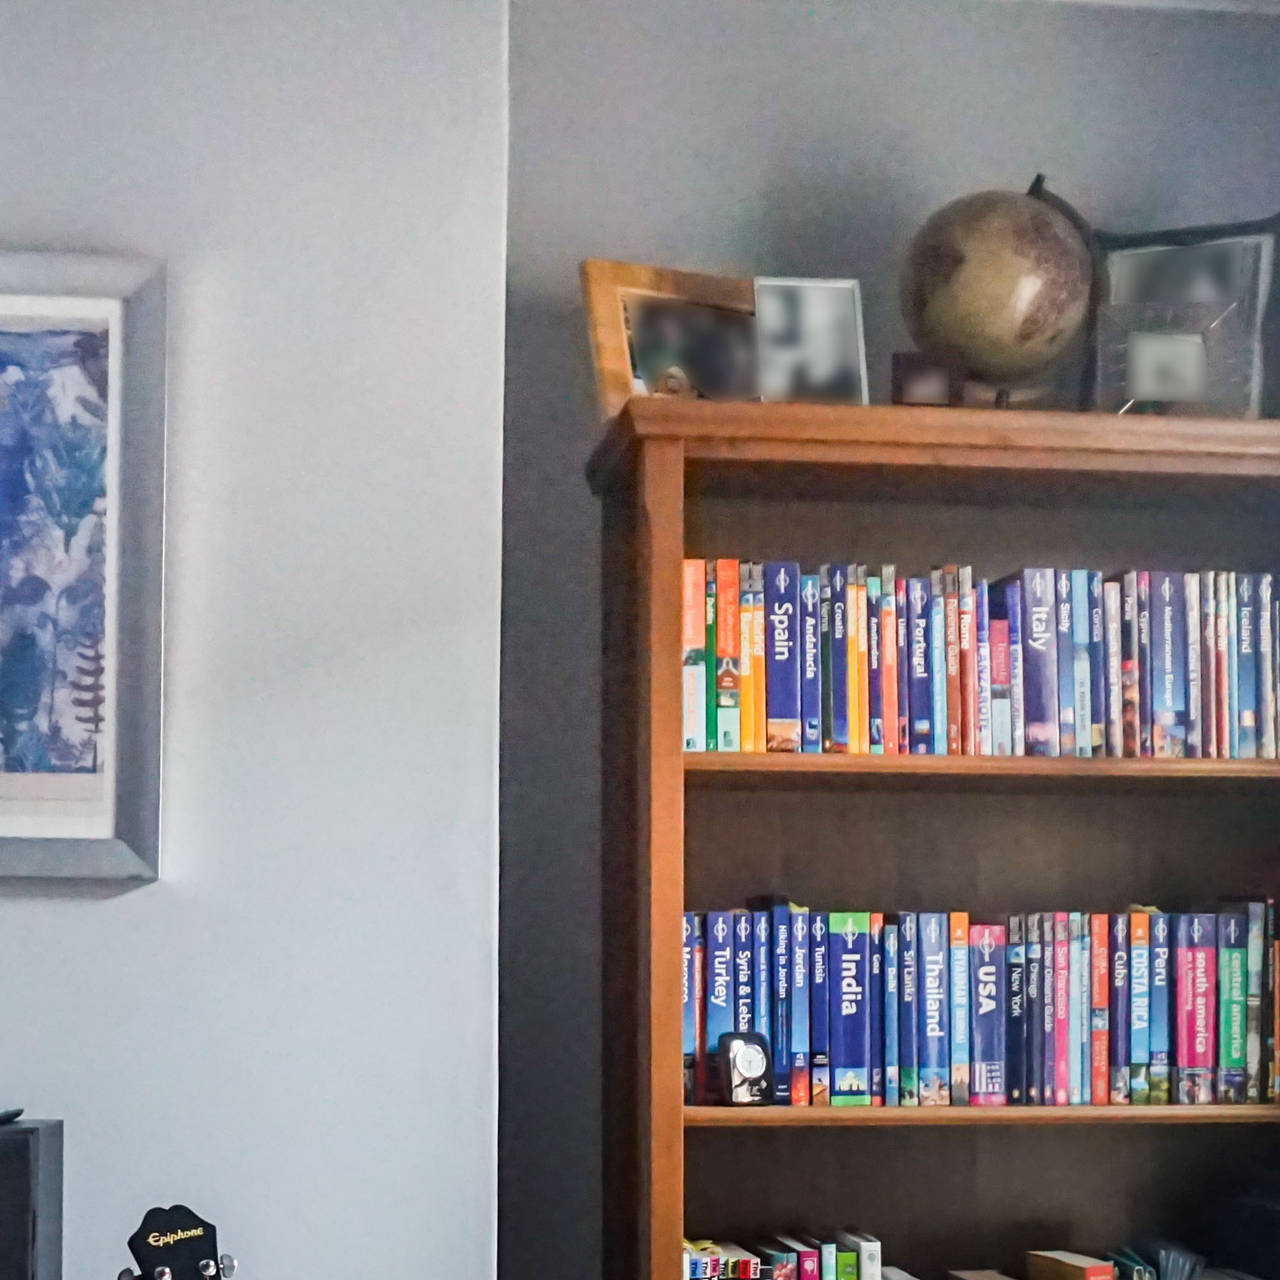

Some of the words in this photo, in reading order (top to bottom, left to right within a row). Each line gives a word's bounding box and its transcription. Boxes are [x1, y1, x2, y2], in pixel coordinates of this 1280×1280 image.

[821, 601, 830, 633] Vienna
[834, 602, 845, 639] Croatia
[1059, 602, 1071, 633] Sicily
[1092, 607, 1102, 642] Corsica
[1124, 597, 1134, 621] Paris
[770, 602, 793, 661] Spain
[869, 617, 879, 669] Amsterdam
[897, 618, 906, 647] Lisbon
[961, 614, 971, 650] Rome
[1028, 606, 1052, 650] Italy
[1140, 611, 1149, 644] Cyprus
[1241, 607, 1252, 653] Iceland
[805, 616, 817, 679] Andalucia
[912, 618, 928, 678] Portugal
[947, 645, 958, 676] Guide
[977, 643, 988, 733] LANZAROTE
[1164, 674, 1175, 708] Europe
[776, 925, 788, 955] Hiking
[1044, 946, 1053, 966] New
[1057, 946, 1066, 967] San
[736, 950, 751, 983] Syria
[778, 956, 788, 965] in
[794, 946, 806, 988] Jordan
[815, 945, 825, 983] Tunisia
[872, 954, 881, 974] Goa
[904, 951, 914, 965] Sri
[1098, 947, 1107, 974] CUBA
[1114, 951, 1128, 987] Cuba
[1132, 949, 1148, 994] COSTA
[1155, 947, 1169, 986] Peru
[1196, 951, 1208, 992] south
[711, 946, 730, 1007] Turkey
[738, 985, 751, 996] &
[778, 966, 788, 999] Jordan
[841, 953, 862, 1016] India
[887, 967, 897, 992] Delhi
[904, 968, 914, 1002] Lanka
[954, 949, 966, 1006] MYANMAR
[978, 965, 997, 1015] USA
[1011, 967, 1022, 991] New
[1028, 962, 1039, 998] Chicago
[1044, 968, 1053, 1004] Orleans
[1057, 969, 1066, 1019] Francisco
[1232, 952, 1243, 1001] central
[926, 952, 944, 1037] Thailand
[1011, 994, 1022, 1017] York
[738, 998, 751, 1032] Leba
[1044, 1005, 1054, 1032] Guide
[1132, 997, 1149, 1030] RICA
[1196, 996, 1207, 1053] america
[1232, 1004, 1243, 1059] america
[147, 1227, 204, 1247] Epiphone
